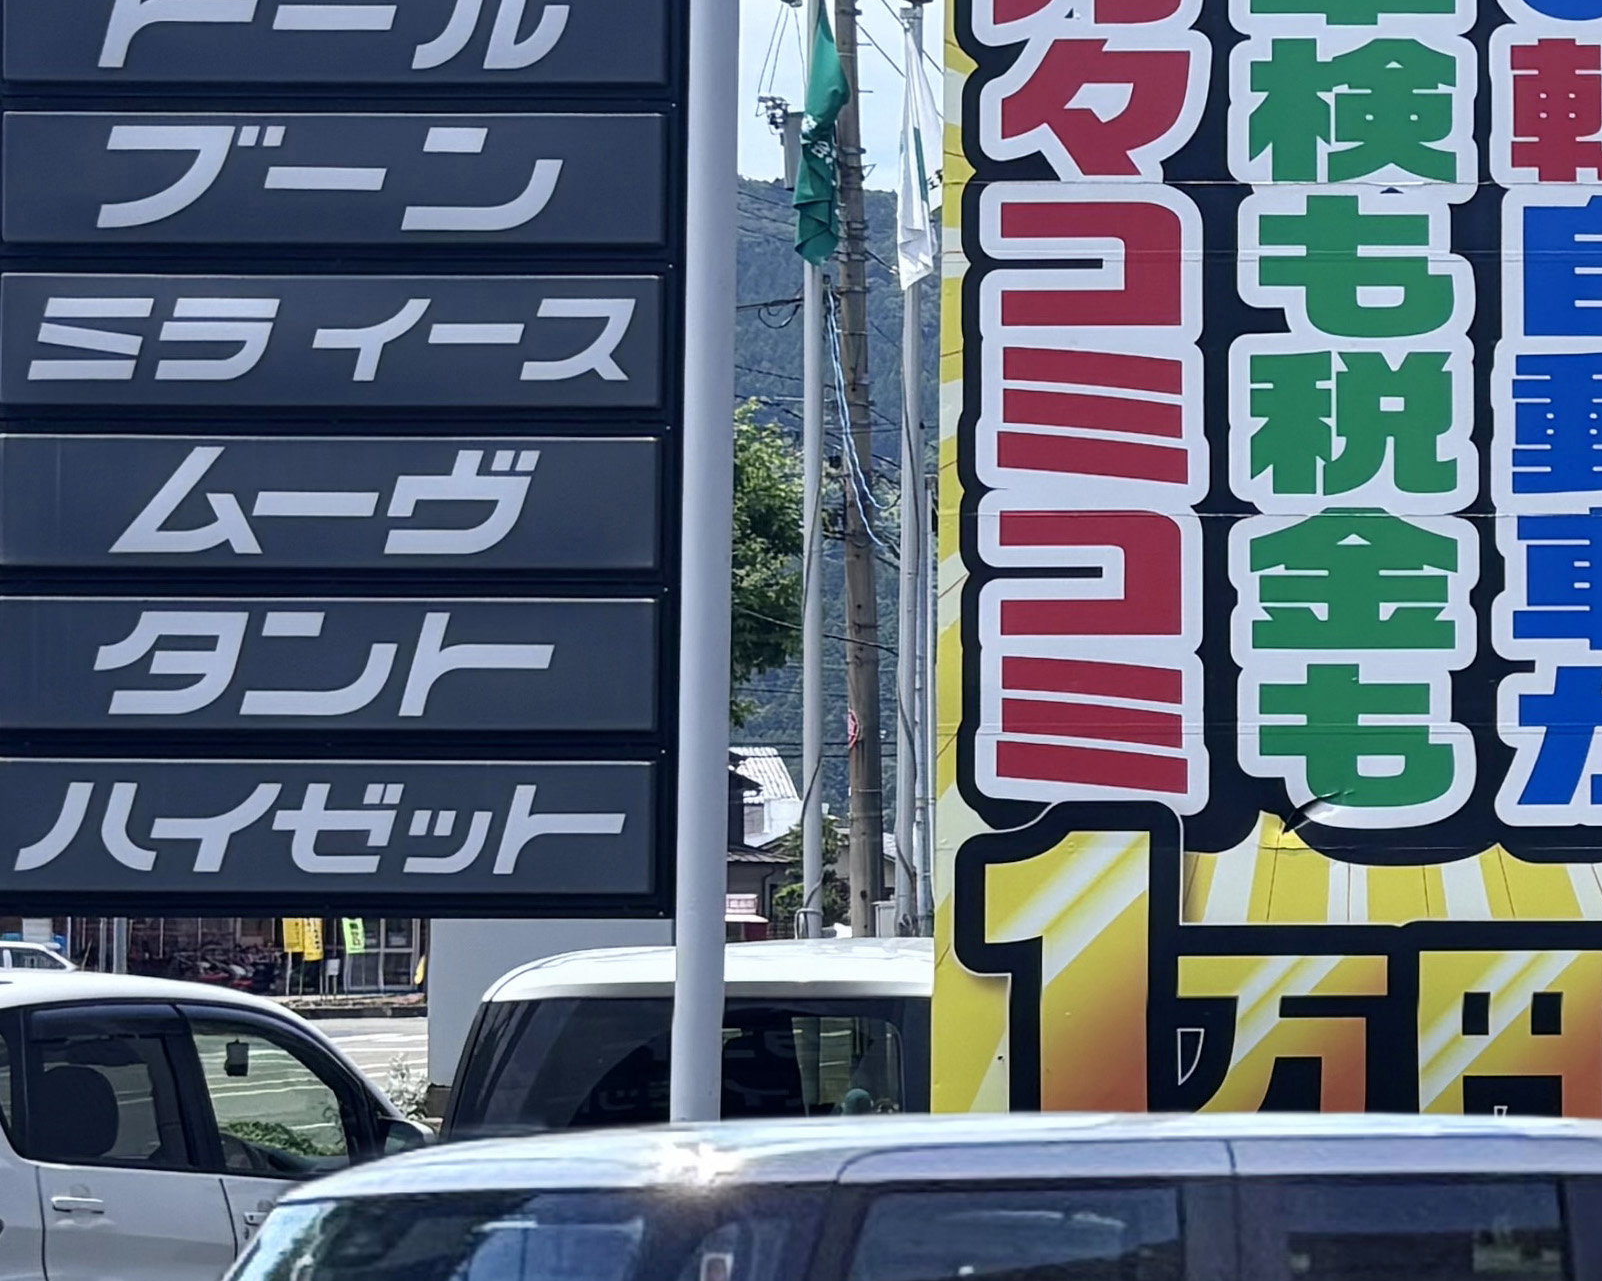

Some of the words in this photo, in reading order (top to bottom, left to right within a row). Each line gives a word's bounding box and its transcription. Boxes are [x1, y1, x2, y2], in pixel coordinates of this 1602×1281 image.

[96, 125, 564, 231] ブーン
[108, 445, 541, 555] ムーヴ
[93, 610, 555, 717] タント
[14, 781, 626, 875] ハイゼット
